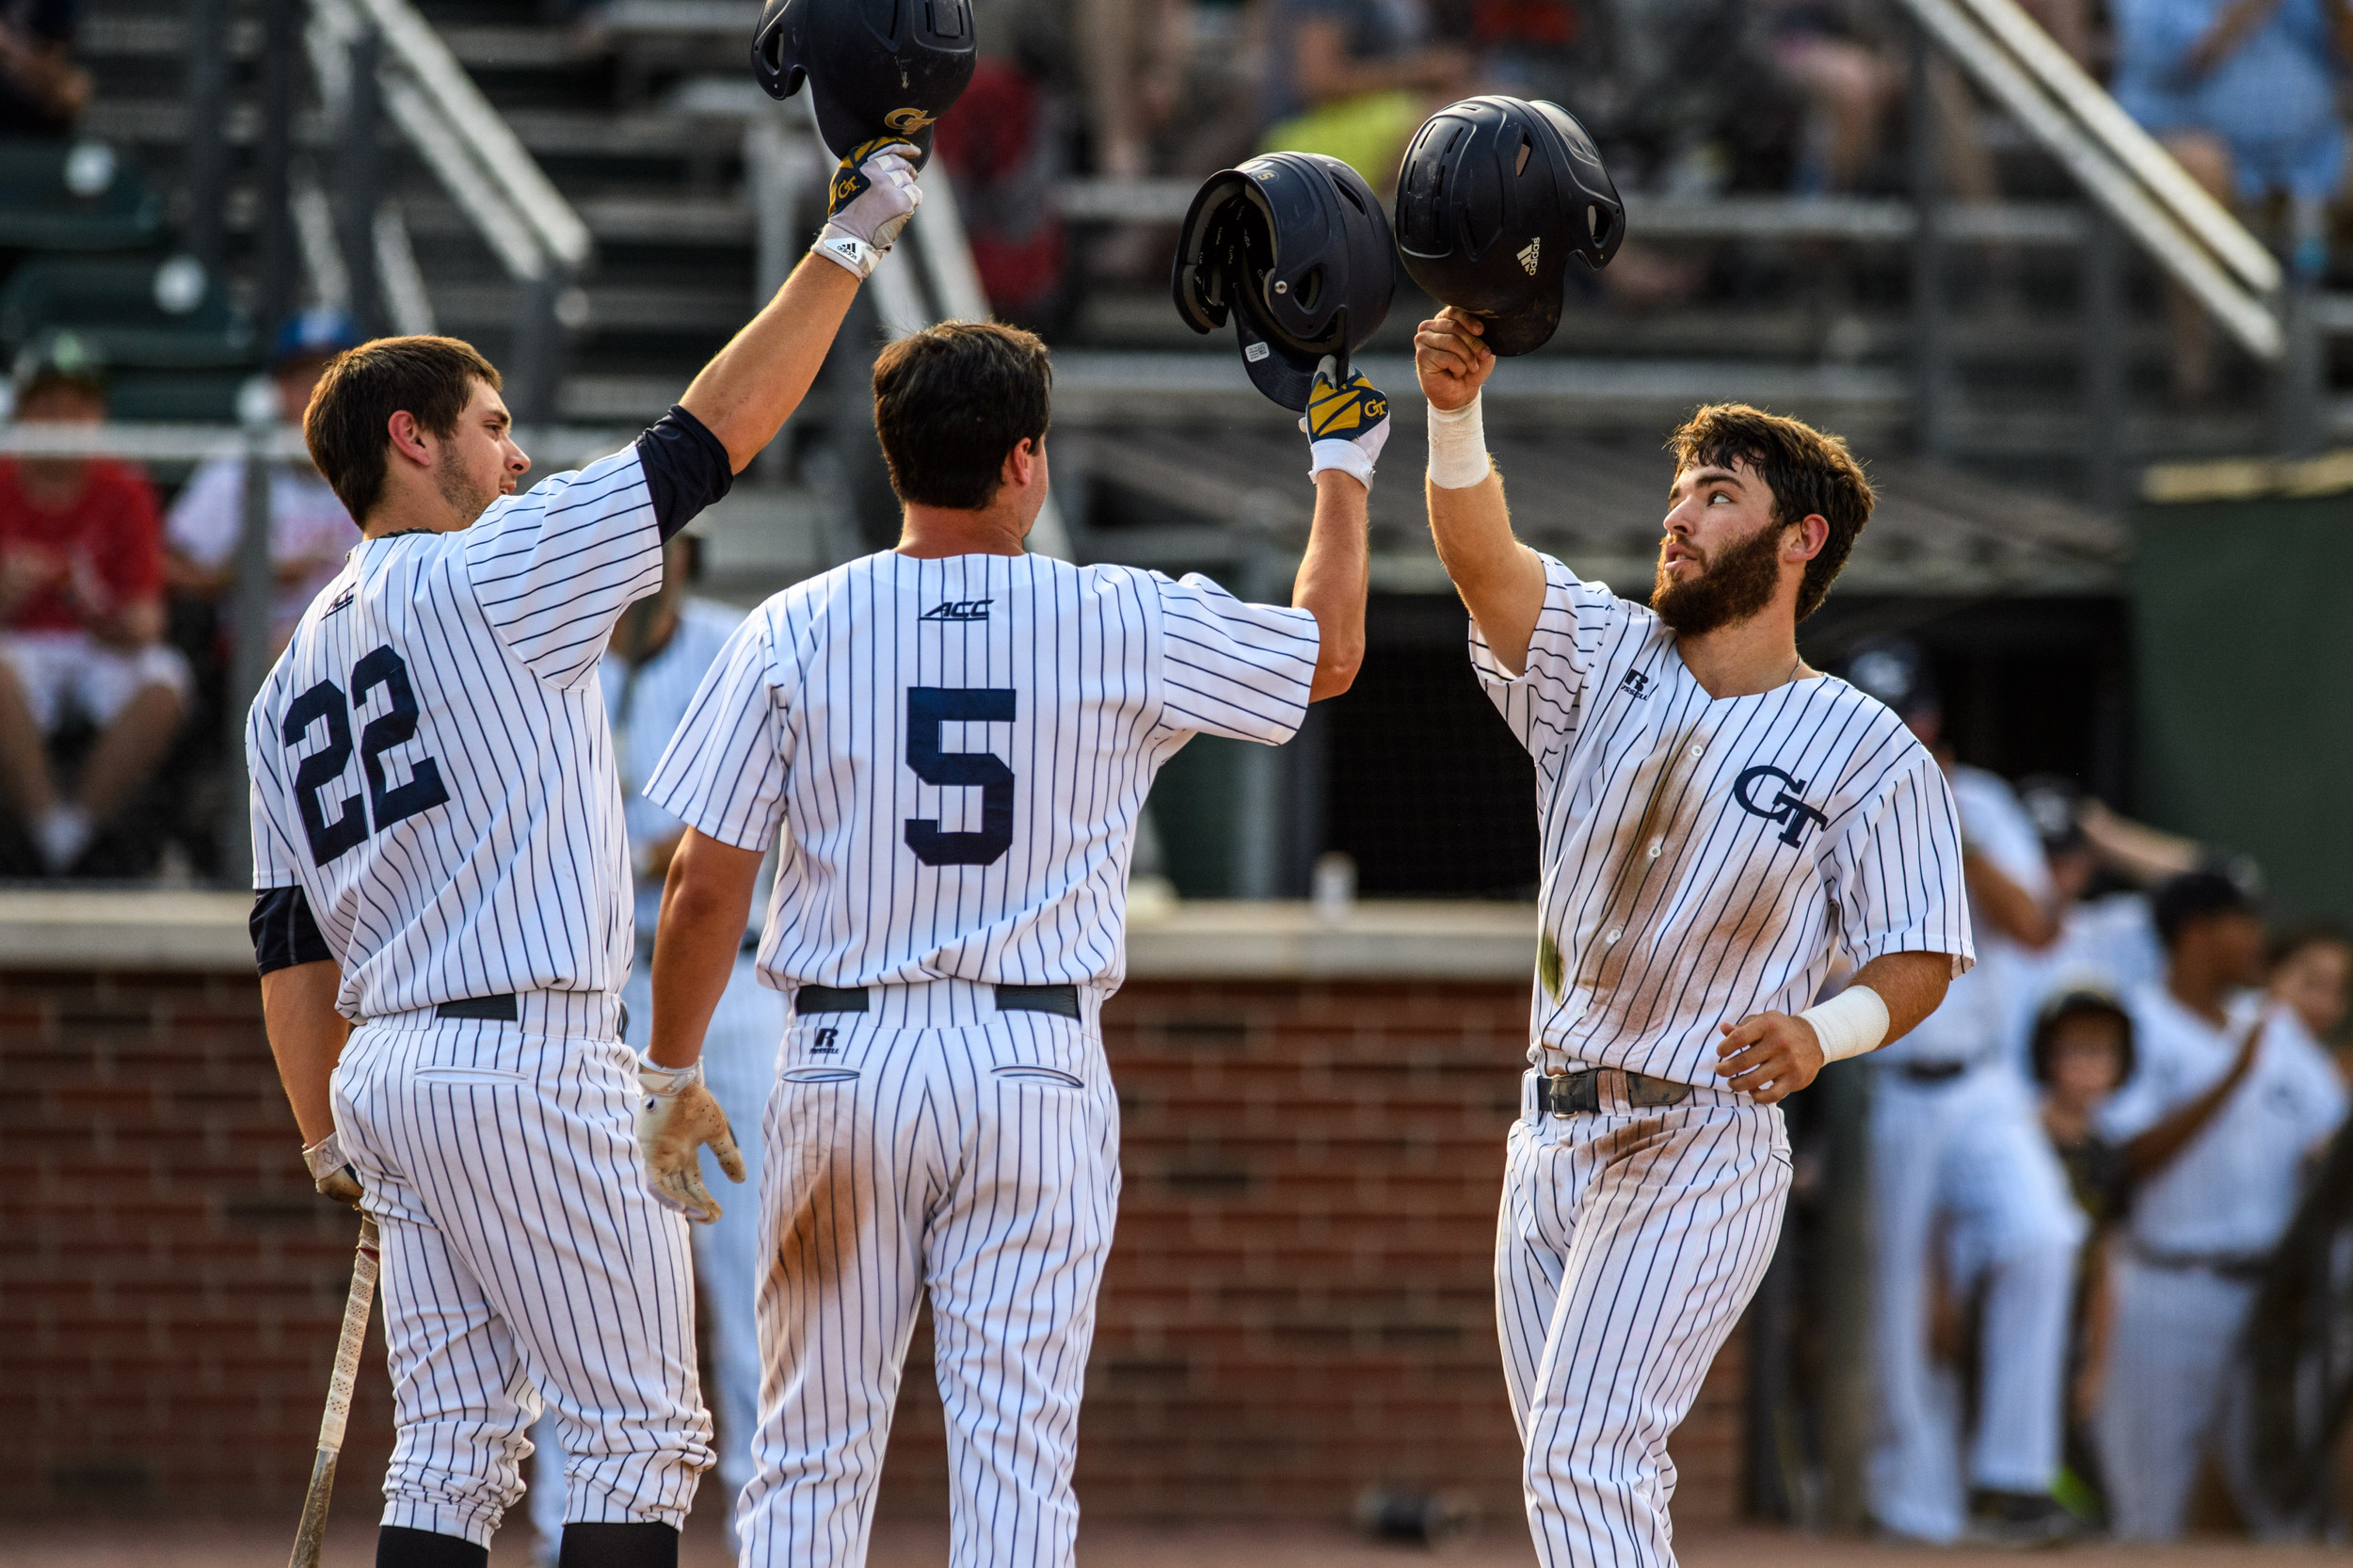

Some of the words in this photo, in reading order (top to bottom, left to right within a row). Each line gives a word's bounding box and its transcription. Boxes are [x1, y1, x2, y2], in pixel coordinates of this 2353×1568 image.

[838, 175, 857, 200] GT
[837, 245, 857, 260] adidas
[1529, 236, 1540, 276] adidas
[1364, 398, 1386, 417] GT
[924, 600, 995, 618] ACC
[282, 644, 451, 868] 22
[904, 686, 1016, 866] 5
[1734, 765, 1829, 849] GT
